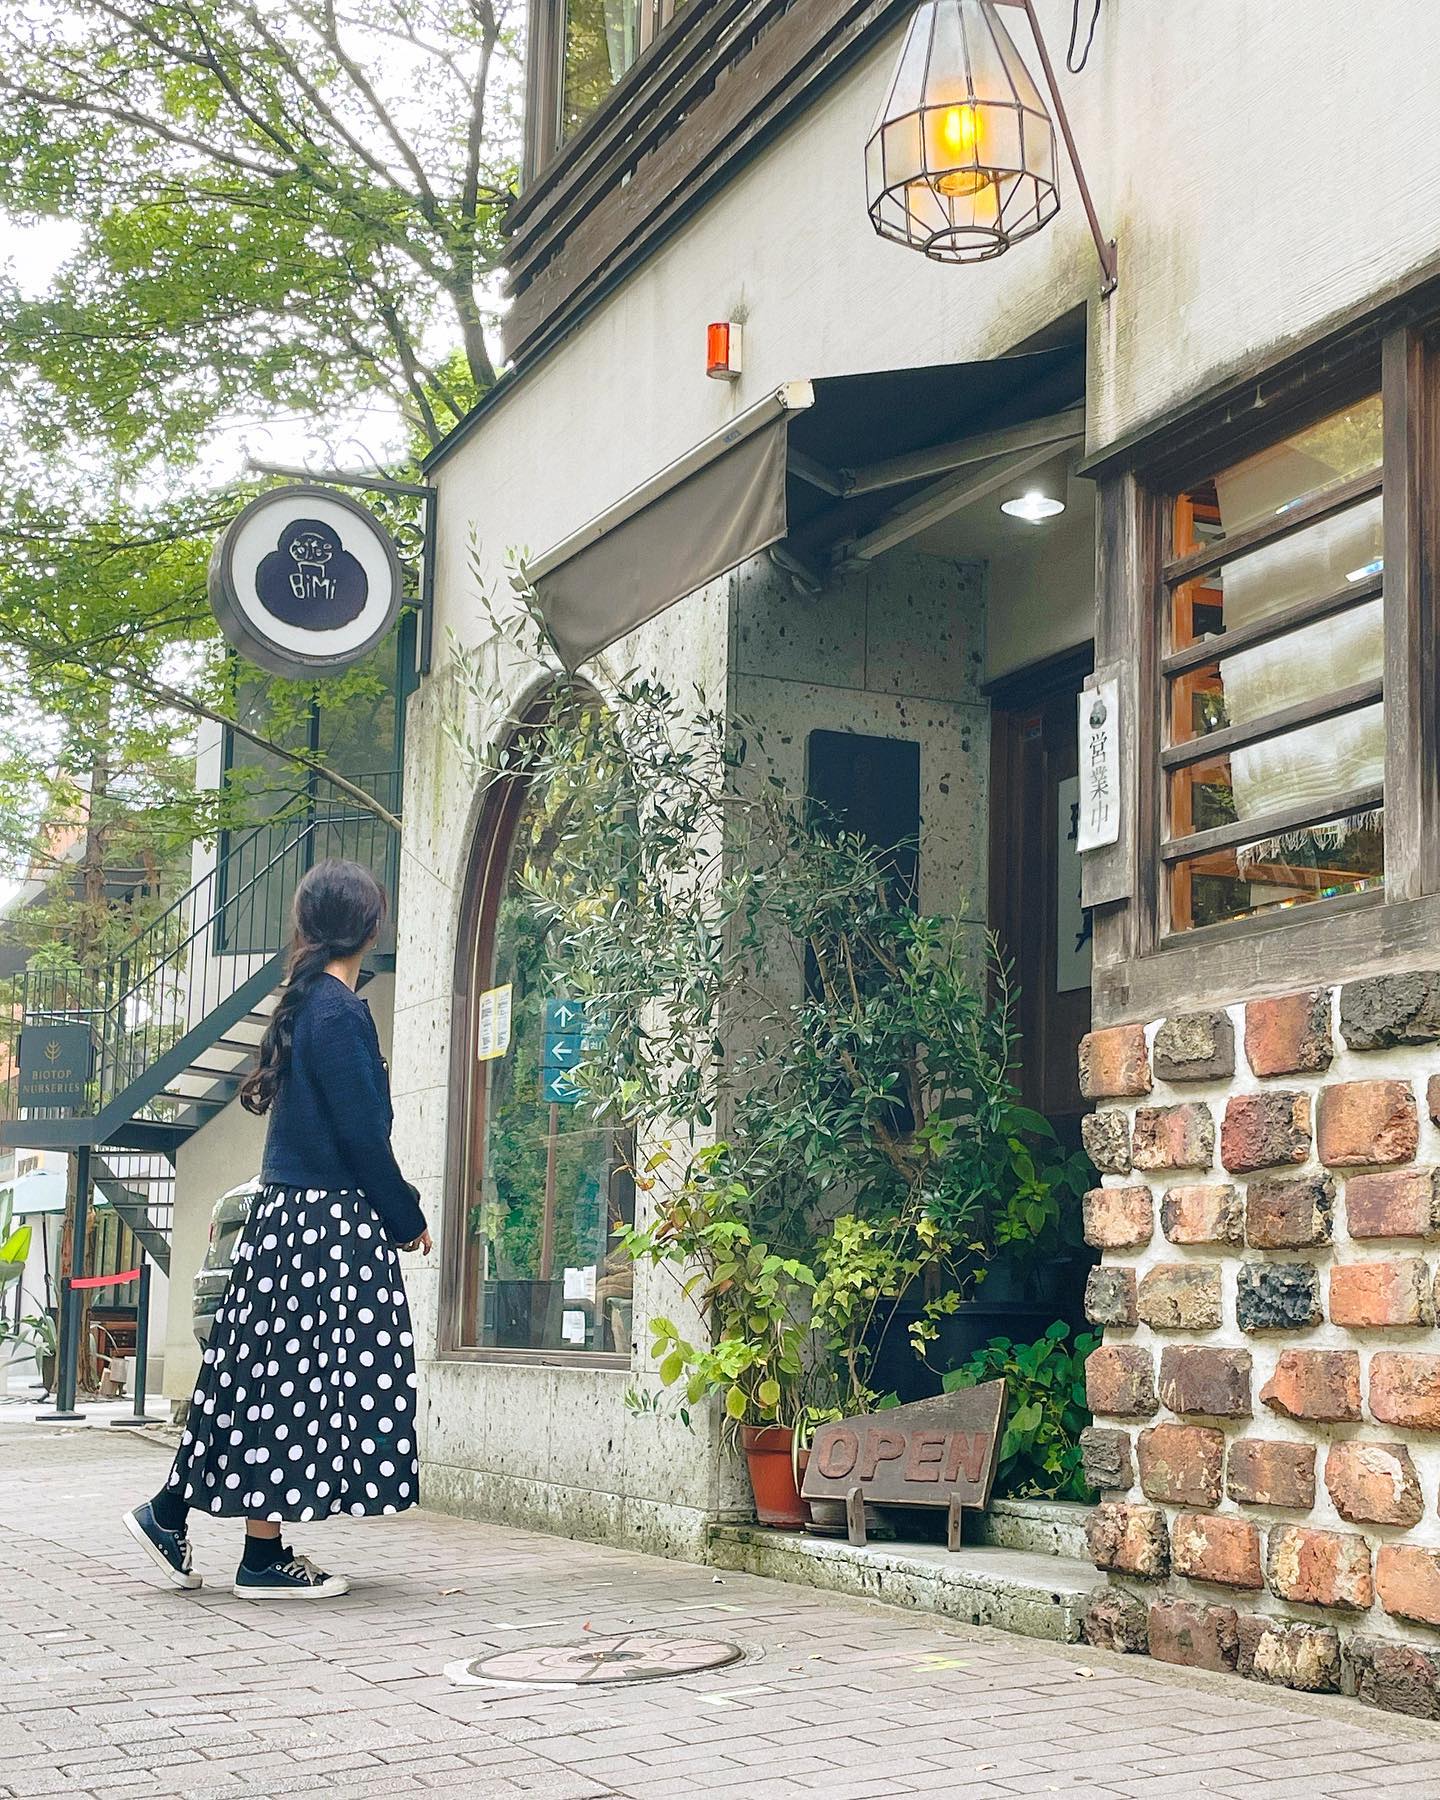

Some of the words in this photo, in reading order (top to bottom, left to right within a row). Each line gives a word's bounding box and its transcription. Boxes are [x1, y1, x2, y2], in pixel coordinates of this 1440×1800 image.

[1089, 731, 1110, 834] 営業中
[23, 1083, 80, 1094] NURSERIES
[32, 1070, 72, 1080] BIOTOP
[817, 1427, 988, 1482] OPEN
